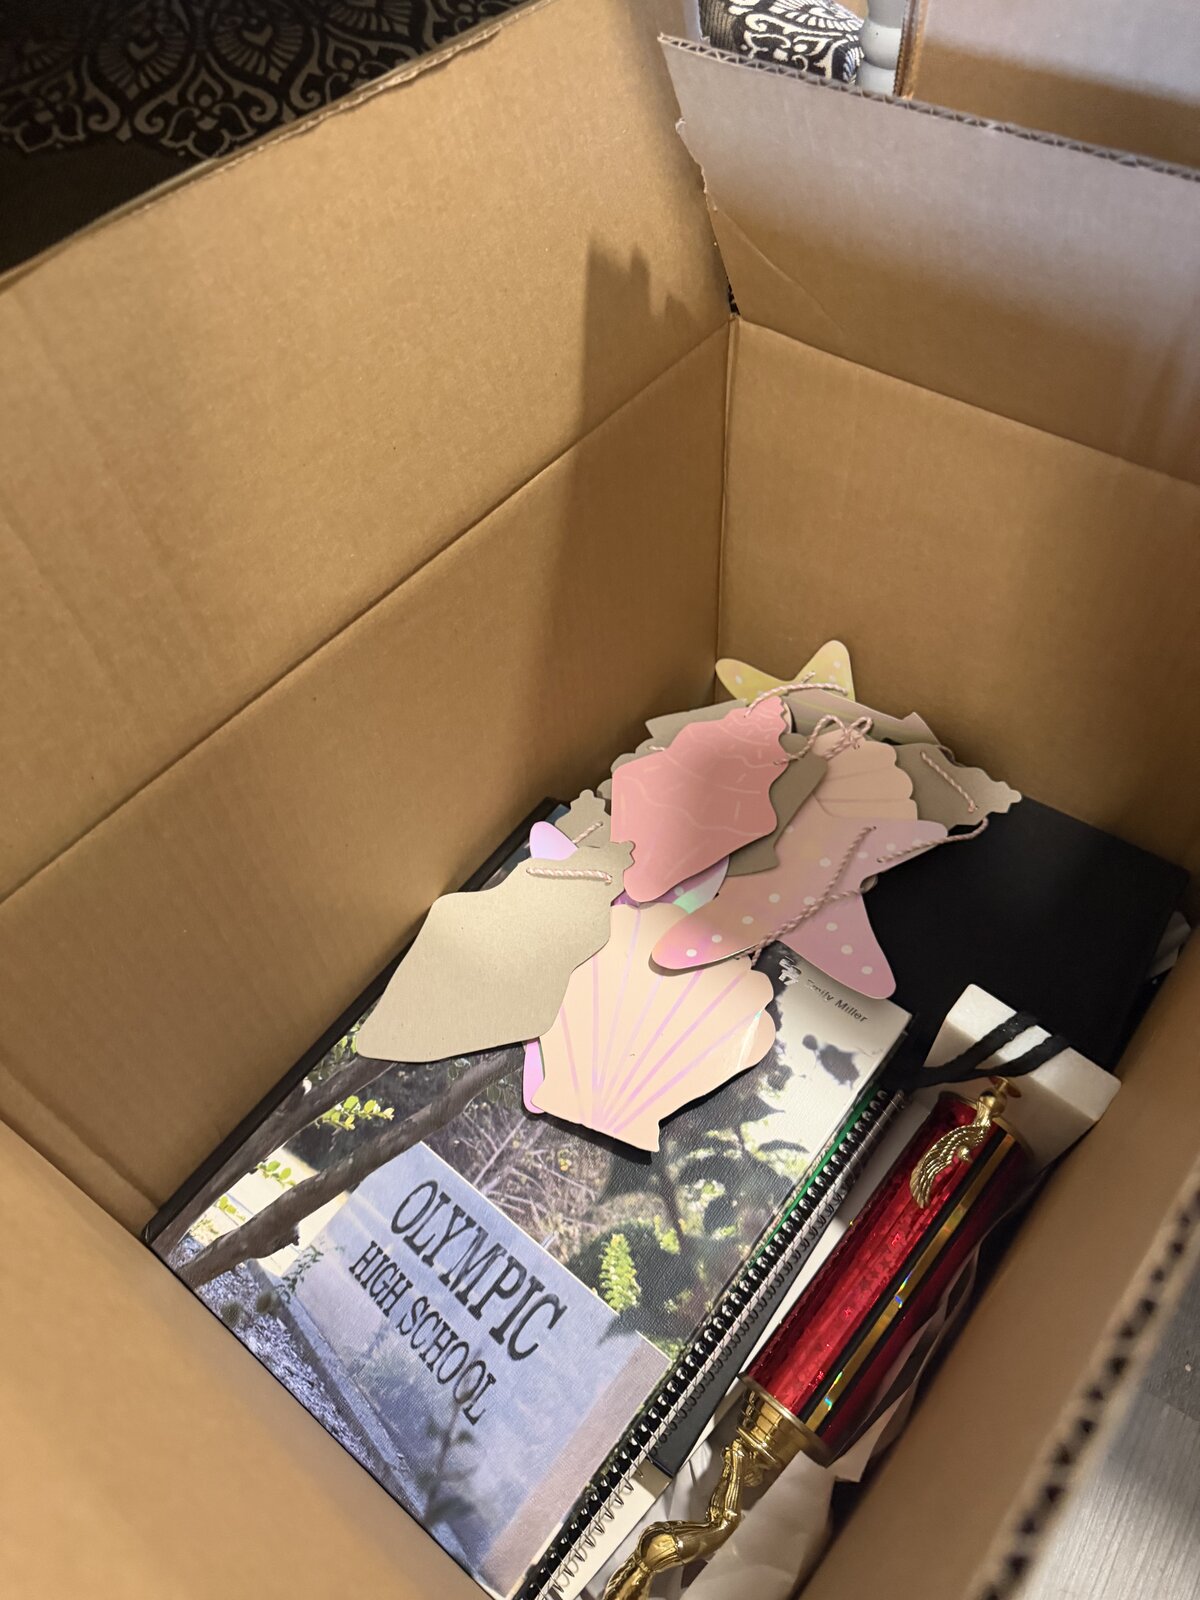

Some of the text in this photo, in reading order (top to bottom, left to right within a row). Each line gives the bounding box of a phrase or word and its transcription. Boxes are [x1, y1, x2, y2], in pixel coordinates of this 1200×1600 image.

[834, 999, 868, 1023] Miller
[349, 1240, 497, 1426] HIGH SCHOOL
[391, 1180, 568, 1361] OLYMPIC
